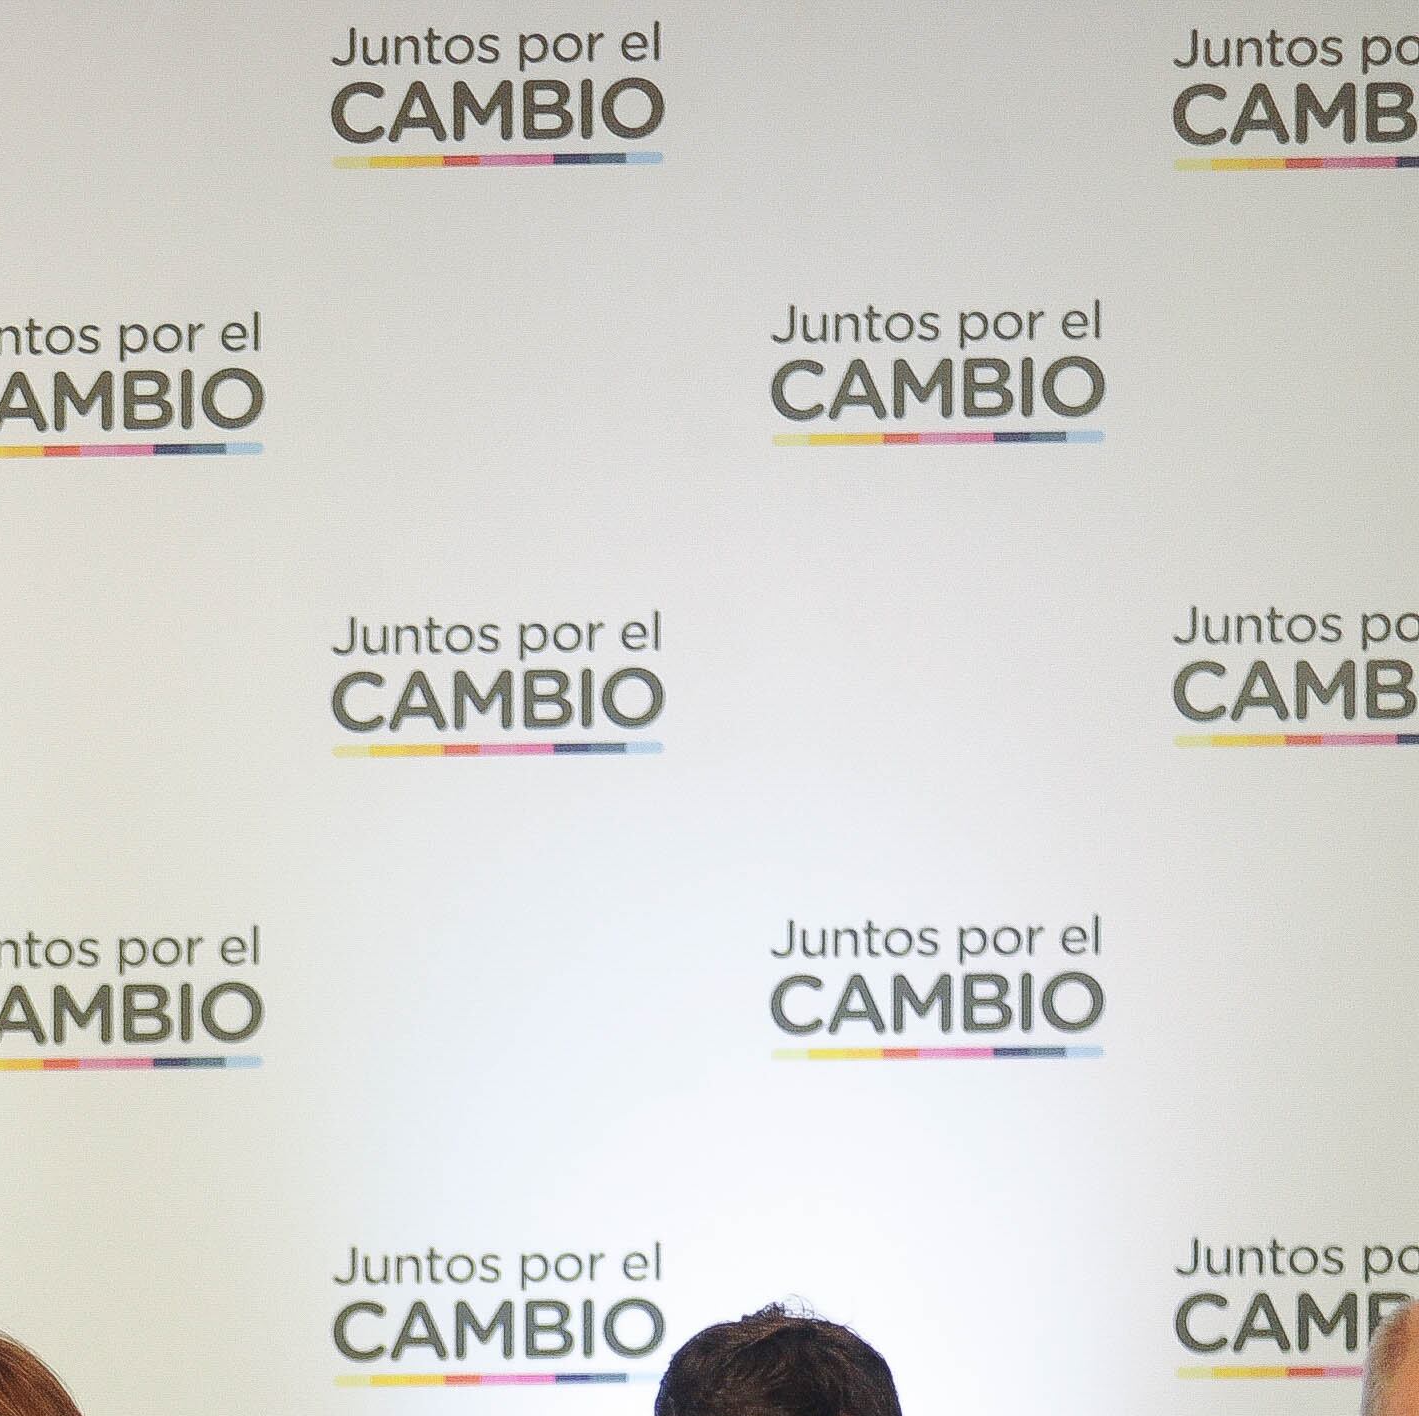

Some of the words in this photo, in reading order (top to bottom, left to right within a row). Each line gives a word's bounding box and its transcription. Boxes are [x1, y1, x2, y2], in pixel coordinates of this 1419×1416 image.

[331, 27, 500, 67] Juntos
[518, 32, 605, 72] por
[620, 20, 661, 62] el
[1173, 28, 1343, 69] Juntos
[1361, 35, 1419, 75] po
[330, 76, 665, 145] CAMBIO
[1172, 81, 1418, 146] CAMB
[119, 323, 204, 363] por
[220, 311, 260, 353] el
[771, 305, 940, 344] Juntos
[959, 310, 1045, 350] por
[1061, 299, 1101, 340] el
[770, 355, 1106, 422] CAMBIO
[332, 617, 500, 656] Juntos
[519, 622, 604, 661] por
[621, 610, 660, 651] el
[1173, 606, 1343, 645] Juntos
[1361, 612, 1419, 651] po
[331, 666, 665, 733] CAMBIO
[1172, 659, 1418, 722] CAMB
[118, 936, 203, 975] por
[220, 925, 259, 966] el
[771, 920, 939, 958] Juntos
[958, 926, 1043, 964] por
[1061, 915, 1100, 955] el
[770, 971, 1105, 1035] CAMBIO
[334, 1247, 500, 1285] Juntos
[520, 1253, 604, 1290] por
[622, 1242, 661, 1281] el
[1176, 1238, 1345, 1276] Juntos
[1363, 1245, 1419, 1283] po
[332, 1297, 666, 1362] CAMBIO
[1174, 1291, 1411, 1354] CAM
